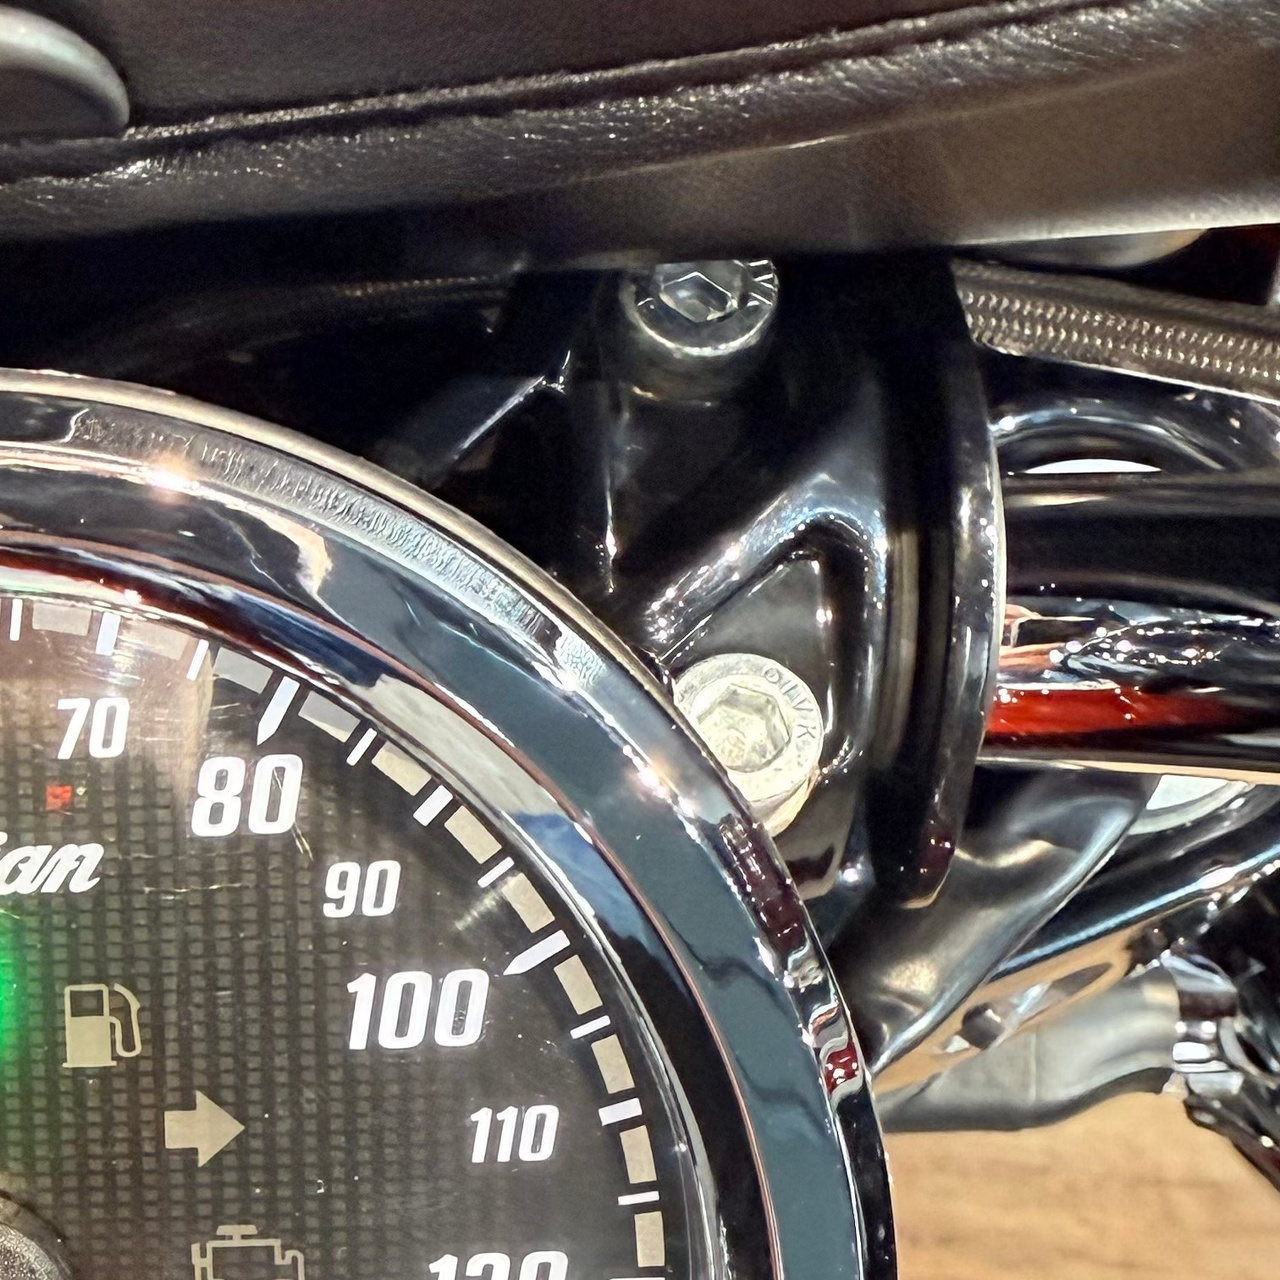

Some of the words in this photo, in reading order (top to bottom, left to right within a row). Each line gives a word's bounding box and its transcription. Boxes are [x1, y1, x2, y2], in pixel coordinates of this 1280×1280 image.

[57, 696, 130, 759] 70
[191, 753, 304, 837] 80
[323, 860, 401, 918] 90
[347, 968, 490, 1050] 100
[470, 1104, 560, 1163] 110
